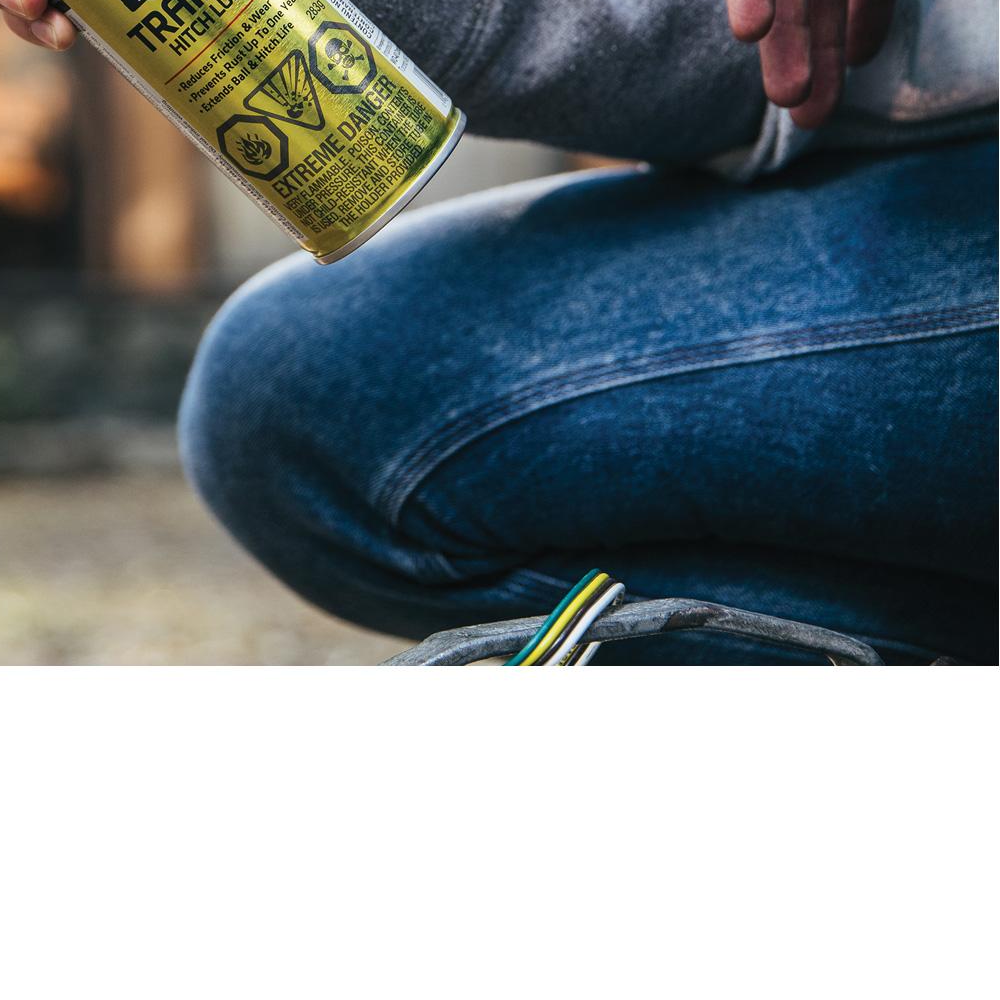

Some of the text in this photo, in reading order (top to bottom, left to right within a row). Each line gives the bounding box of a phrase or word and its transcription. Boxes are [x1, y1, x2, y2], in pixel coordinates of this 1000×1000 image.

[169, 10, 216, 57] HITCH
[180, 0, 274, 92] Reduces Friction & Wear
[191, 68, 227, 103] Prevents
[223, 48, 247, 72] Rust
[243, 36, 260, 54] Up
[255, 25, 270, 40] To
[266, 9, 285, 28] One
[201, 21, 295, 113] Extends Ball & Hitch Life
[340, 7, 373, 39] CONTENU
[272, 134, 346, 200] EXTREME
[337, 74, 397, 142] DANGER
[283, 195, 303, 211] VERY
[300, 154, 351, 200] FLAMMABLE.
[377, 86, 410, 126] CONTENTS
[293, 198, 319, 219] UNDER
[315, 161, 361, 203] PRESSURE.
[356, 143, 378, 166] THIS
[374, 102, 412, 146] CONTAINER
[407, 95, 417, 106] IS
[300, 101, 426, 228] NOT CHILD-RESISTANT WHEN THE TUBE
[310, 112, 433, 234] IS USED. REMOVE AND STORE TUBE IN
[338, 142, 426, 227] THE HOLDER PROVIDED.
